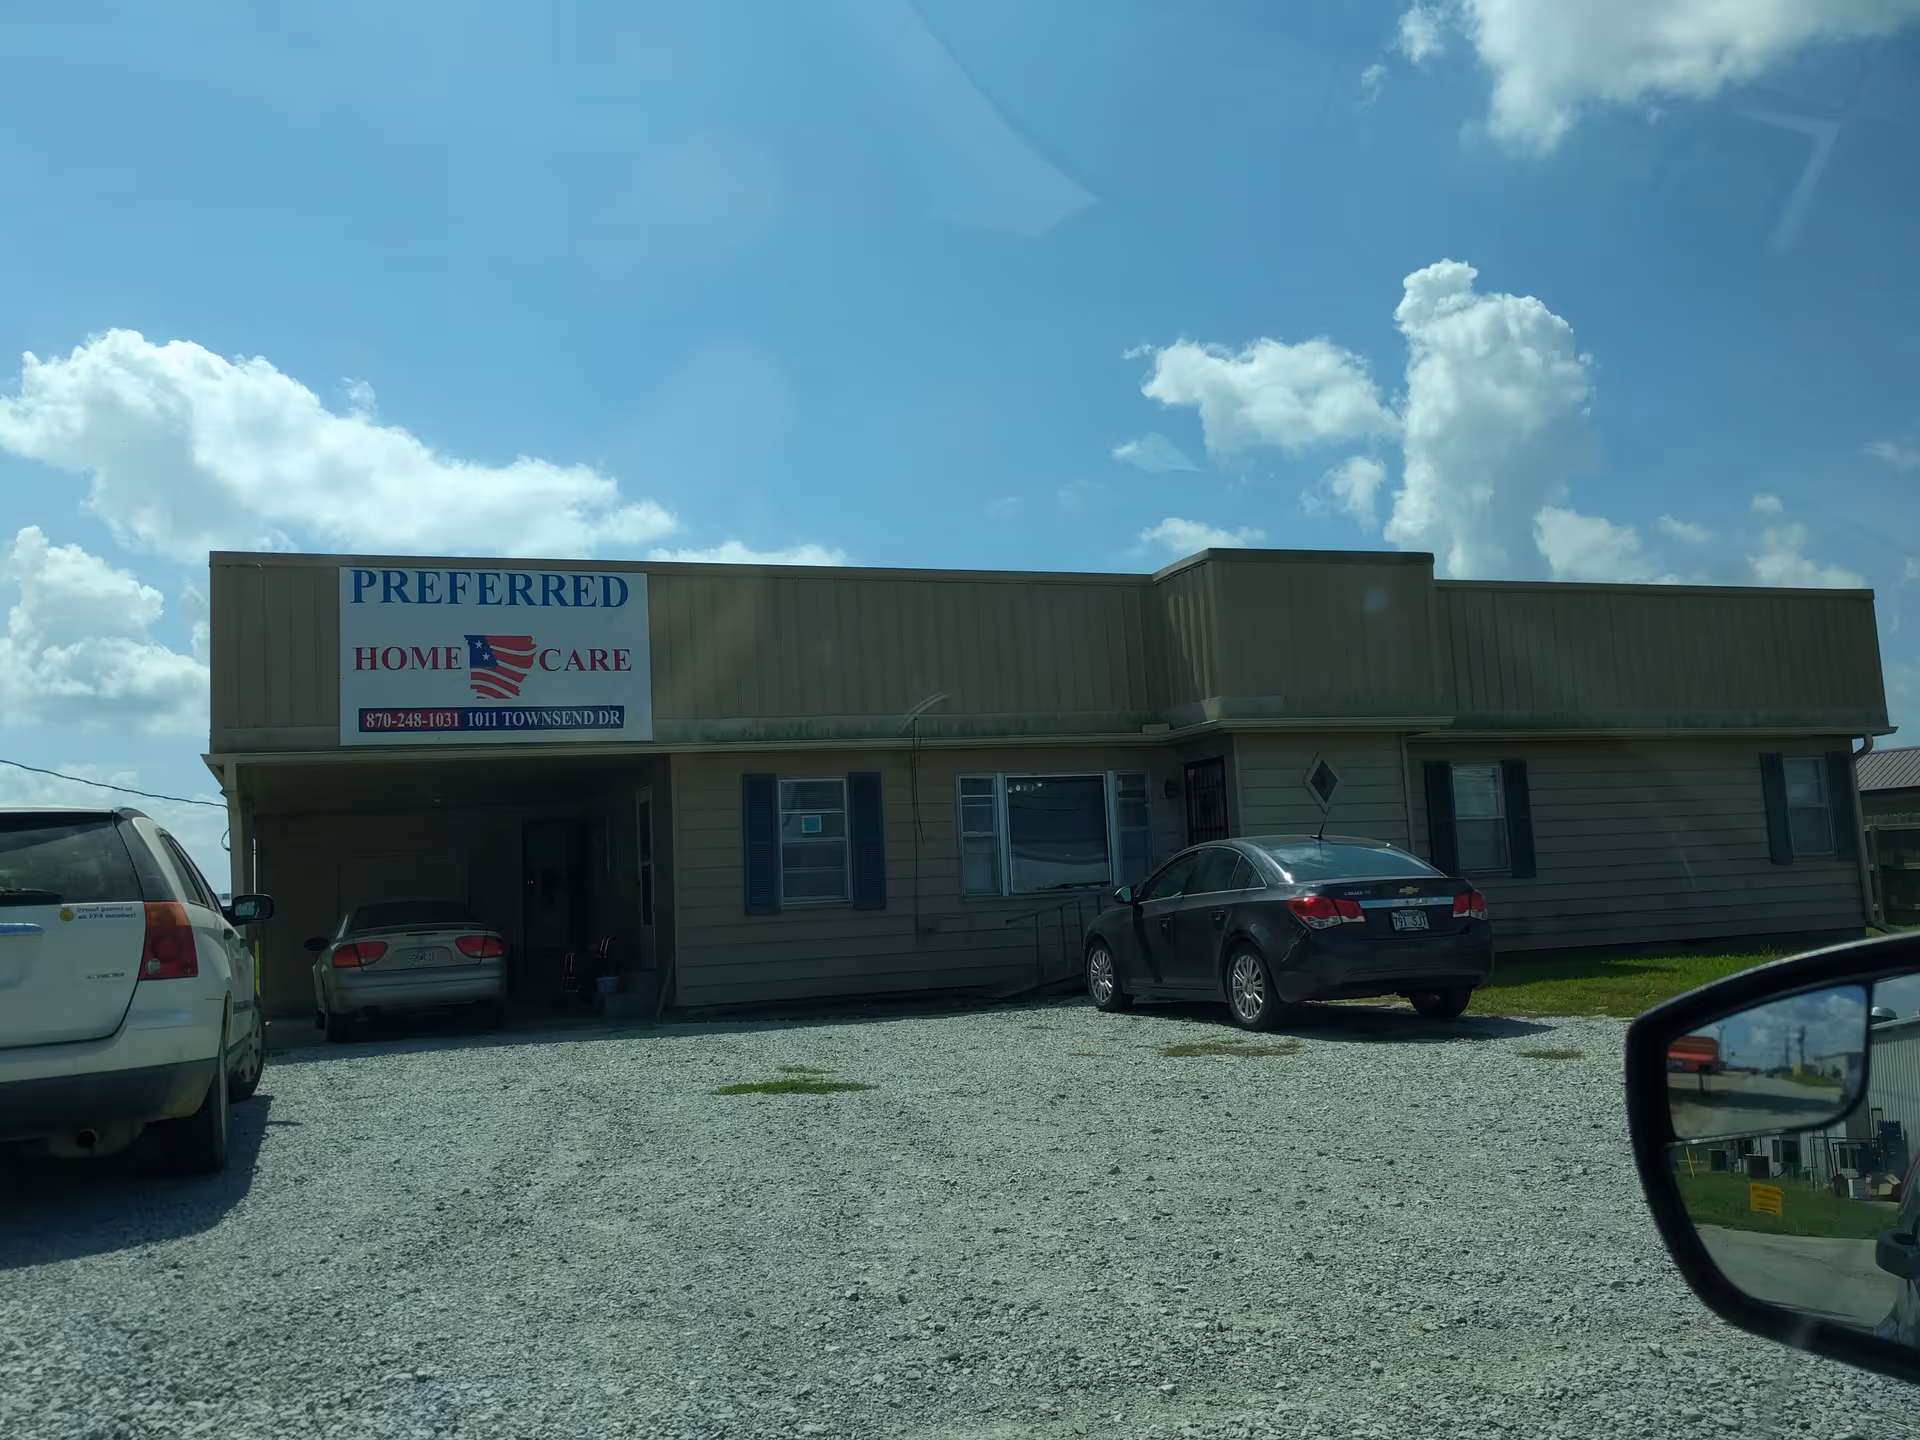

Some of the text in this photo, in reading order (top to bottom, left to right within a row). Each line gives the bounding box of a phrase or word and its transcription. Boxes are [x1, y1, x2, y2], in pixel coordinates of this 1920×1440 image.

[350, 569, 629, 608] PREFERRED
[353, 646, 633, 672] HOME CARE
[366, 710, 621, 728] 870-248-1031 1011 TOWNSEND DR
[1393, 916, 1406, 928] 791
